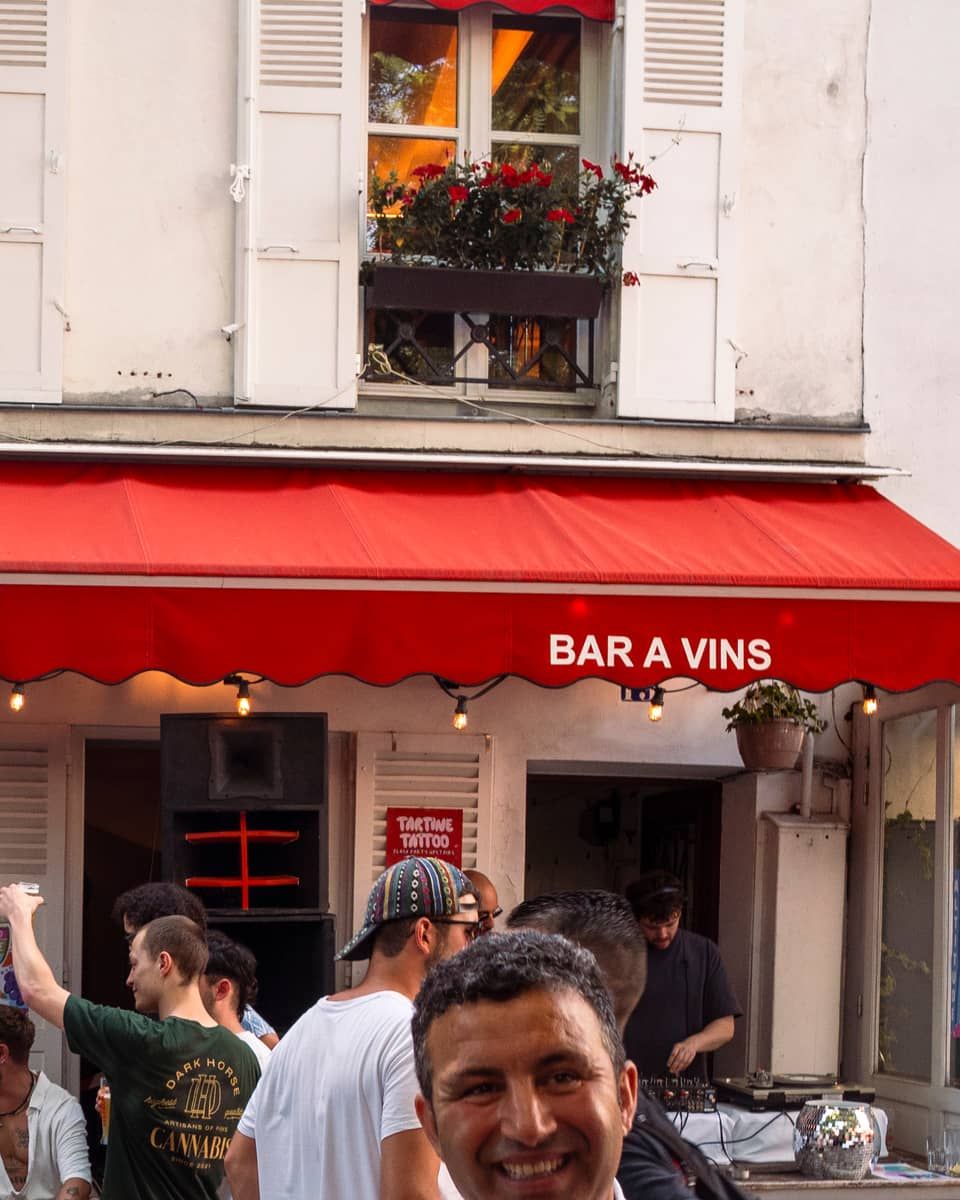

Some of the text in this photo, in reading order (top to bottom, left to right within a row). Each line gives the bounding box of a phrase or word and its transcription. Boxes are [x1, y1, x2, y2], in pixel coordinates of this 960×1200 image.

[549, 633, 772, 671] BAR A VINS
[395, 815, 454, 832] TARTINE
[399, 832, 450, 849] TATTOO
[166, 1058, 240, 1097] DARK HORSE
[164, 1119, 202, 1131] ARTISANS
